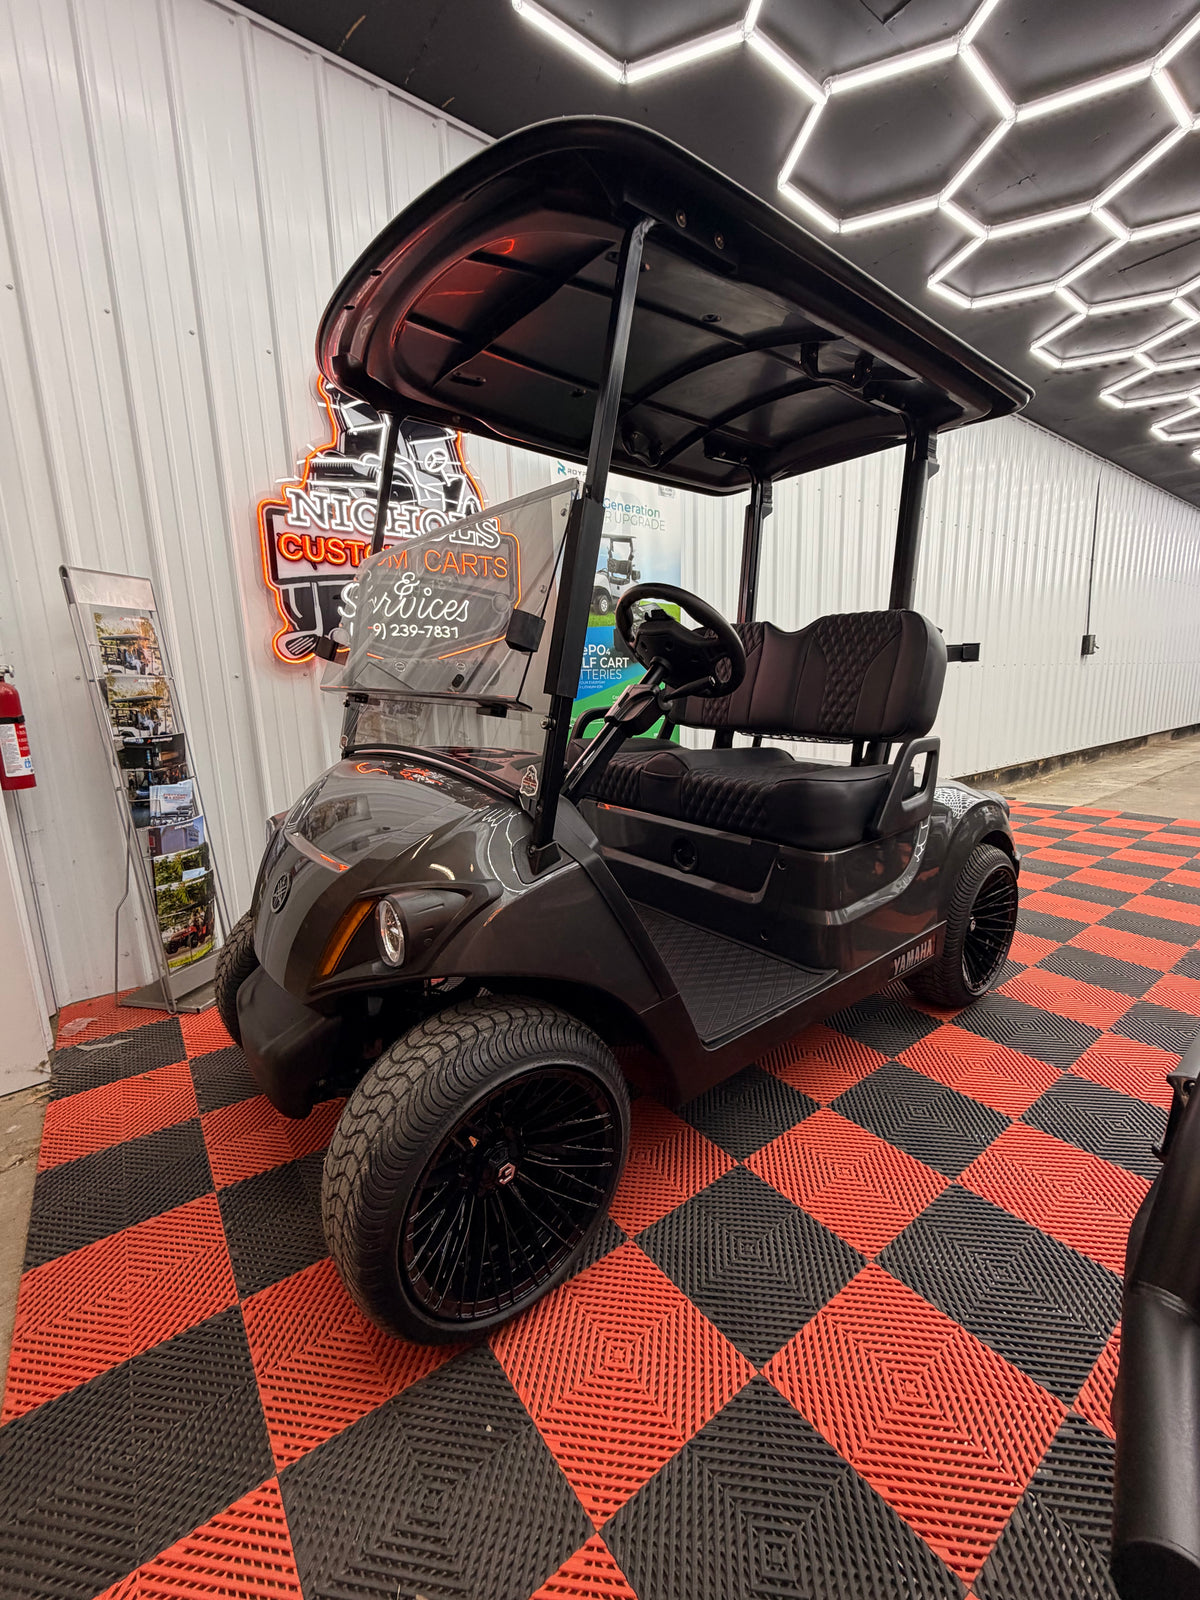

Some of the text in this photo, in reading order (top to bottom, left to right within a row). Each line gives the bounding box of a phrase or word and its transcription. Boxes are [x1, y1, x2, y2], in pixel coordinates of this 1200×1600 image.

[602, 497, 660, 518] Generation
[614, 511, 666, 532] UPGRADE
[424, 549, 508, 578] CARTS
[394, 571, 420, 600] &
[337, 582, 470, 622] Srvices
[390, 624, 459, 639] 239-7831
[582, 657, 629, 669] LF CART
[580, 669, 622, 680] TTERIES
[893, 938, 933, 976] YAMAHA
